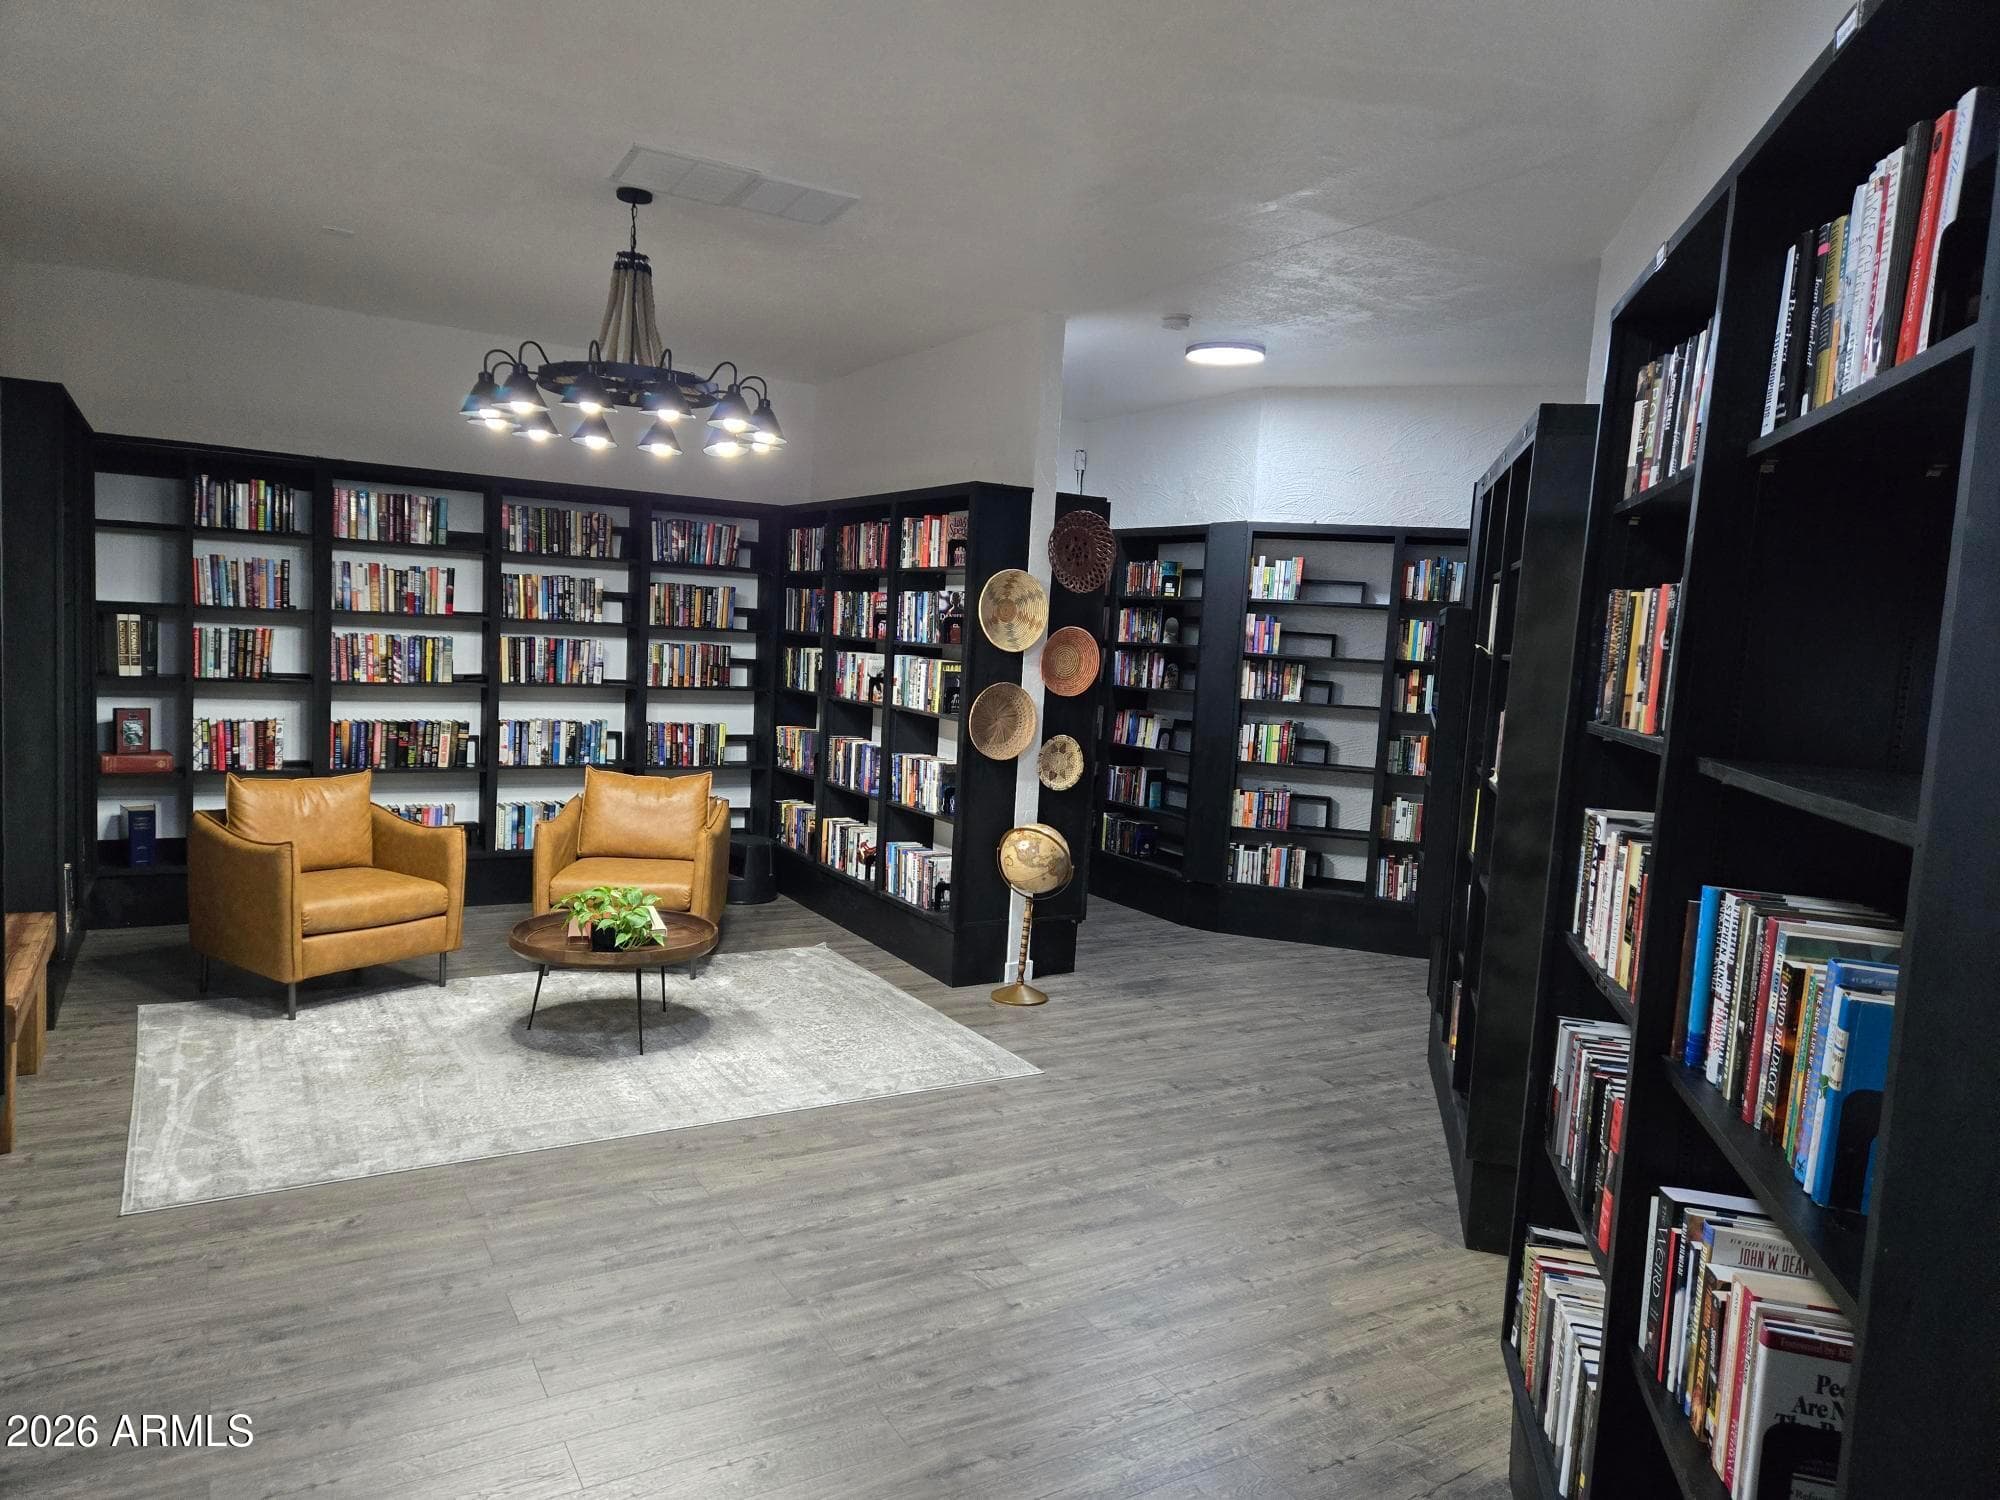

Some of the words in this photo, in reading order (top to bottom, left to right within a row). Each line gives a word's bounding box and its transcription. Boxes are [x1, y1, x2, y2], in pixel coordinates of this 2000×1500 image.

[1919, 175, 1935, 240] DUCHESS
[1827, 224, 1838, 273] FURIOUS
[1812, 276, 1821, 302] Joan
[1905, 258, 1921, 322] WINDSOR
[1806, 305, 1819, 366] Sutherland
[1720, 904, 1732, 954] STEPHEN
[1716, 959, 1725, 988] KING
[1776, 982, 1788, 1025] DAVID
[1811, 1007, 1821, 1035] SECRET
[1713, 1007, 1724, 1051] FINDERS
[1766, 1027, 1783, 1097] BALDACCI
[1532, 1265, 1538, 1289] MY
[1650, 1228, 1668, 1297] WEIRD
[1738, 1246, 1765, 1269] JOHN
[1768, 1252, 1778, 1271] W.
[1782, 1254, 1809, 1276] DEAN
[1528, 1293, 1536, 1333] TURN
[1699, 1330, 1707, 1358] JOE
[1745, 1317, 1754, 1355] Imperial
[1793, 1395, 1829, 1418] Are
